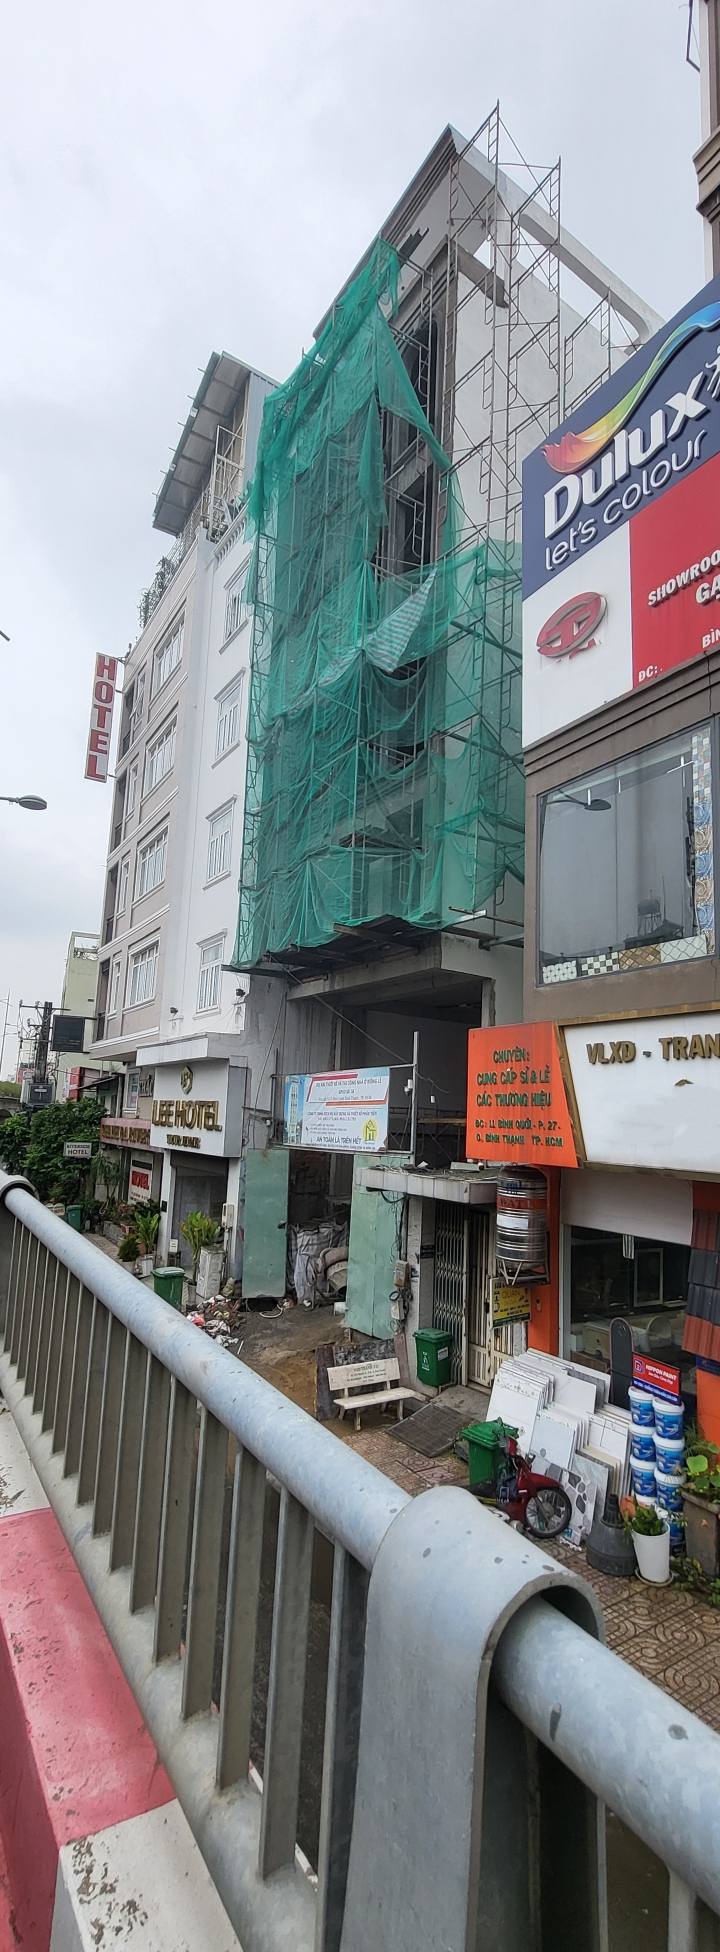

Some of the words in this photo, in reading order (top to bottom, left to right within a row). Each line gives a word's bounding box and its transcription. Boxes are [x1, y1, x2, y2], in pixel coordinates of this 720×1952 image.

[544, 371, 707, 538] Dulux
[545, 520, 598, 571] let's
[603, 428, 706, 523] colour
[86, 655, 117, 780] HOTEL
[586, 1041, 637, 1064] VLXD
[477, 1072, 497, 1086] CUNG
[476, 1091, 491, 1107] CÁC
[152, 1100, 175, 1127] LEE
[175, 1100, 222, 1132] HOTEL
[545, 1137, 563, 1147] HCM
[662, 1371, 677, 1381] PAINT
